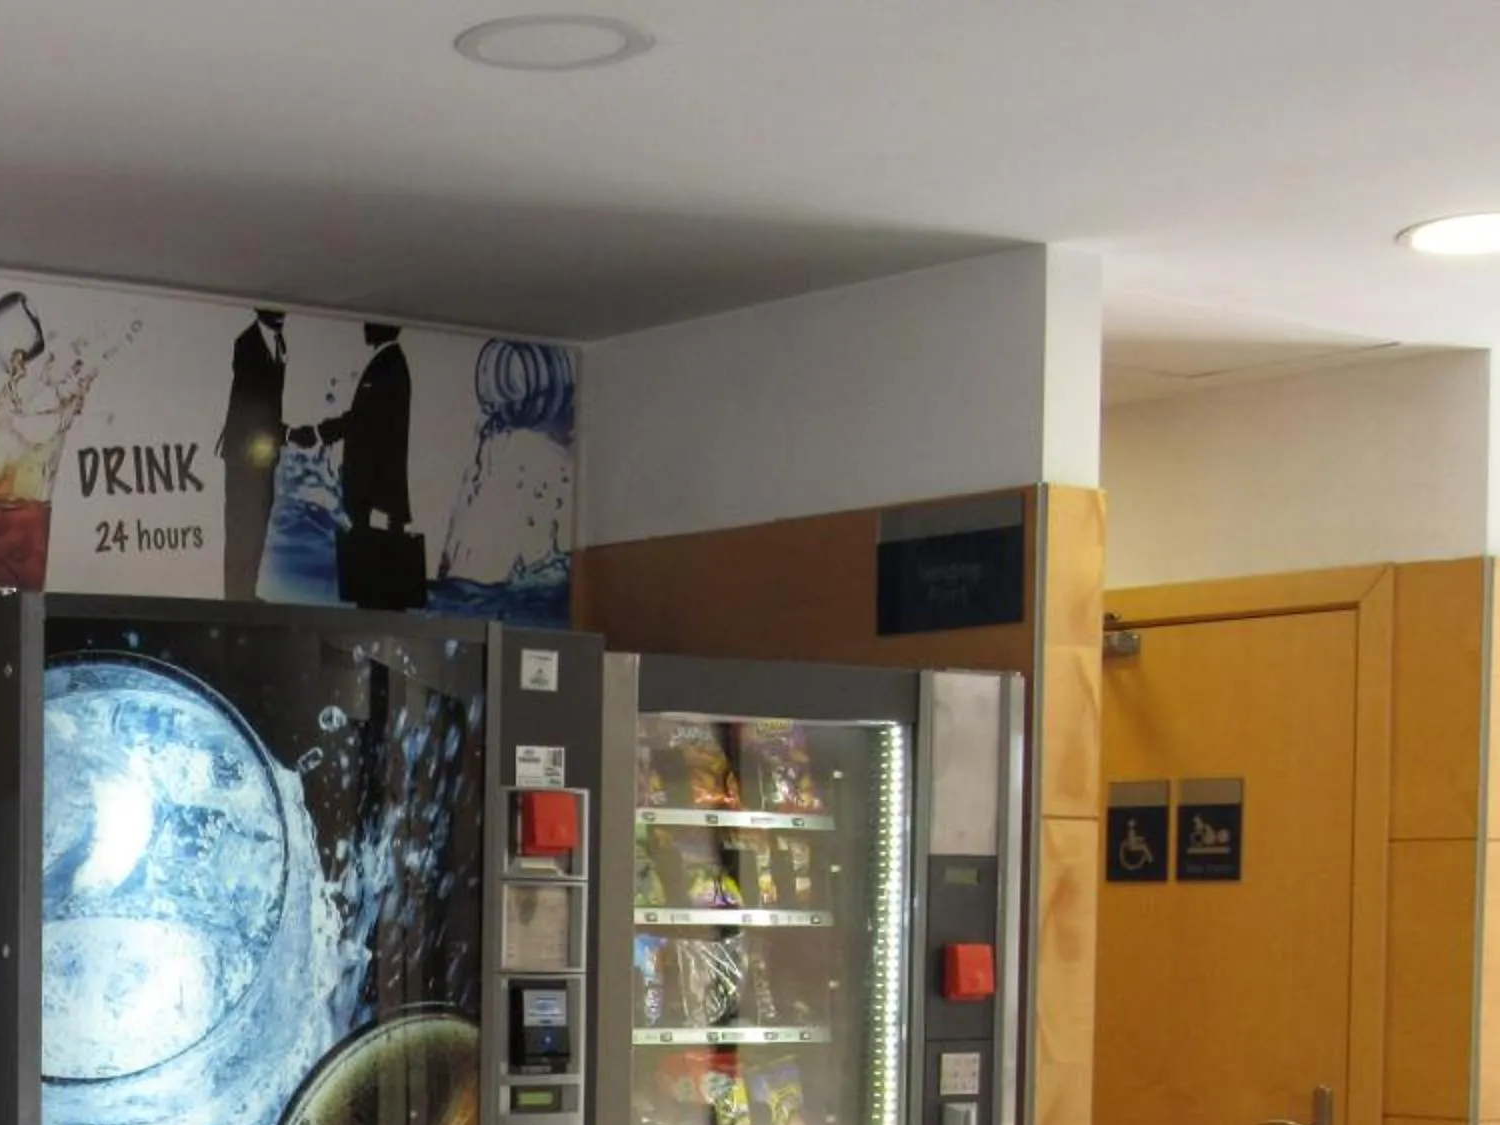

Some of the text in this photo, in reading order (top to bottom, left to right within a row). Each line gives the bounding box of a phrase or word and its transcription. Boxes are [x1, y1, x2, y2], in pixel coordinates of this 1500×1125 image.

[77, 443, 205, 498] DRINK
[95, 518, 204, 553] 24 hours
